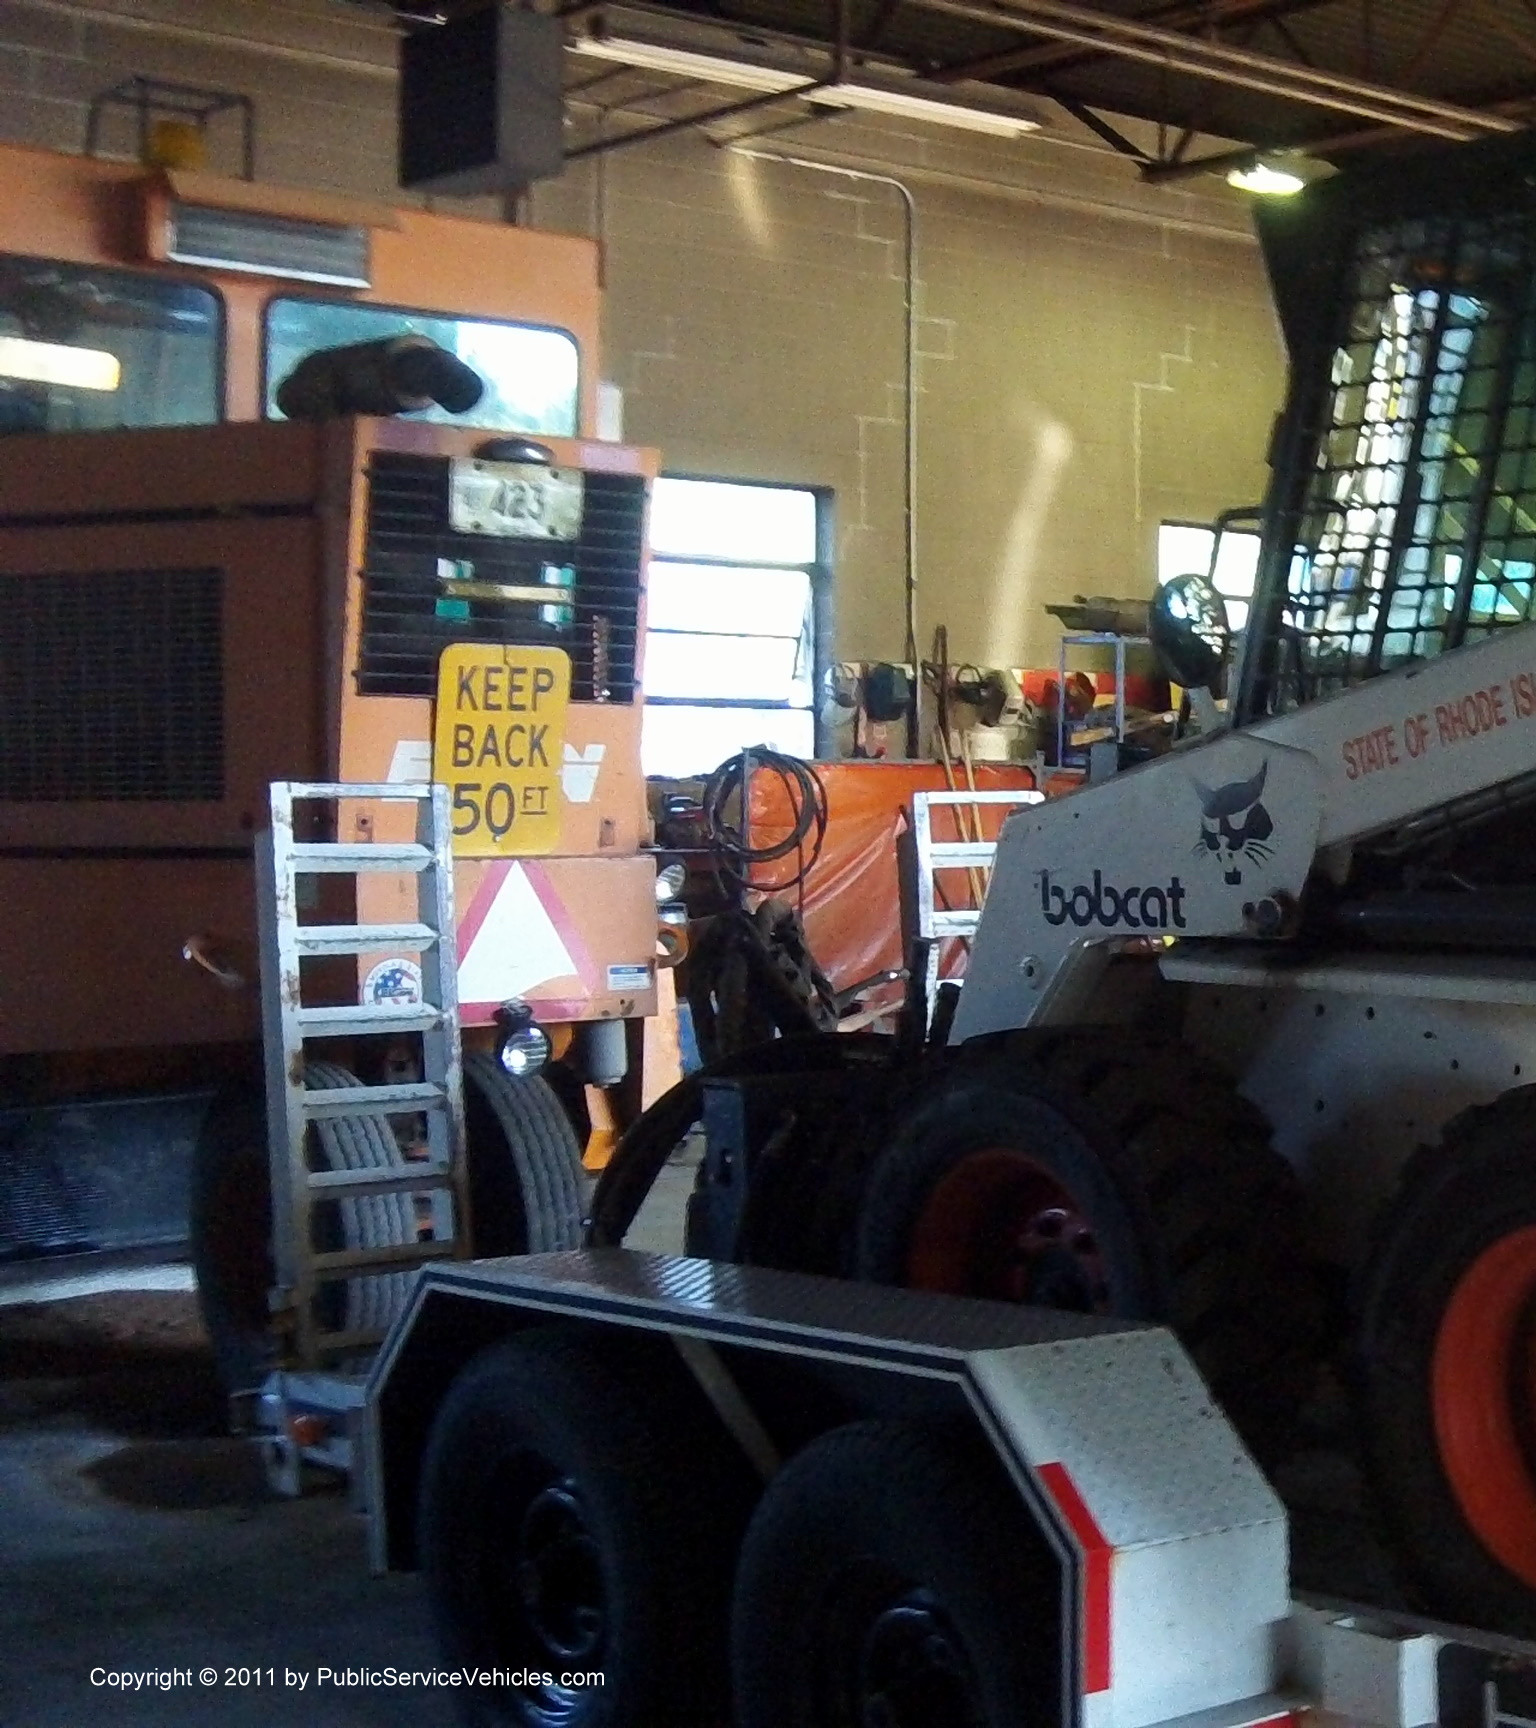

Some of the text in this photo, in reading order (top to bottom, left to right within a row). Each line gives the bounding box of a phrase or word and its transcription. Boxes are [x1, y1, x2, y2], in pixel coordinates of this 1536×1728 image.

[456, 665, 554, 711] KEEP
[452, 723, 549, 767] BACK
[1342, 725, 1399, 780] STATE
[1403, 713, 1429, 758] OF
[1434, 685, 1507, 746] RHODE
[451, 782, 549, 836] 50 FT
[1040, 869, 1187, 928] bobcat
